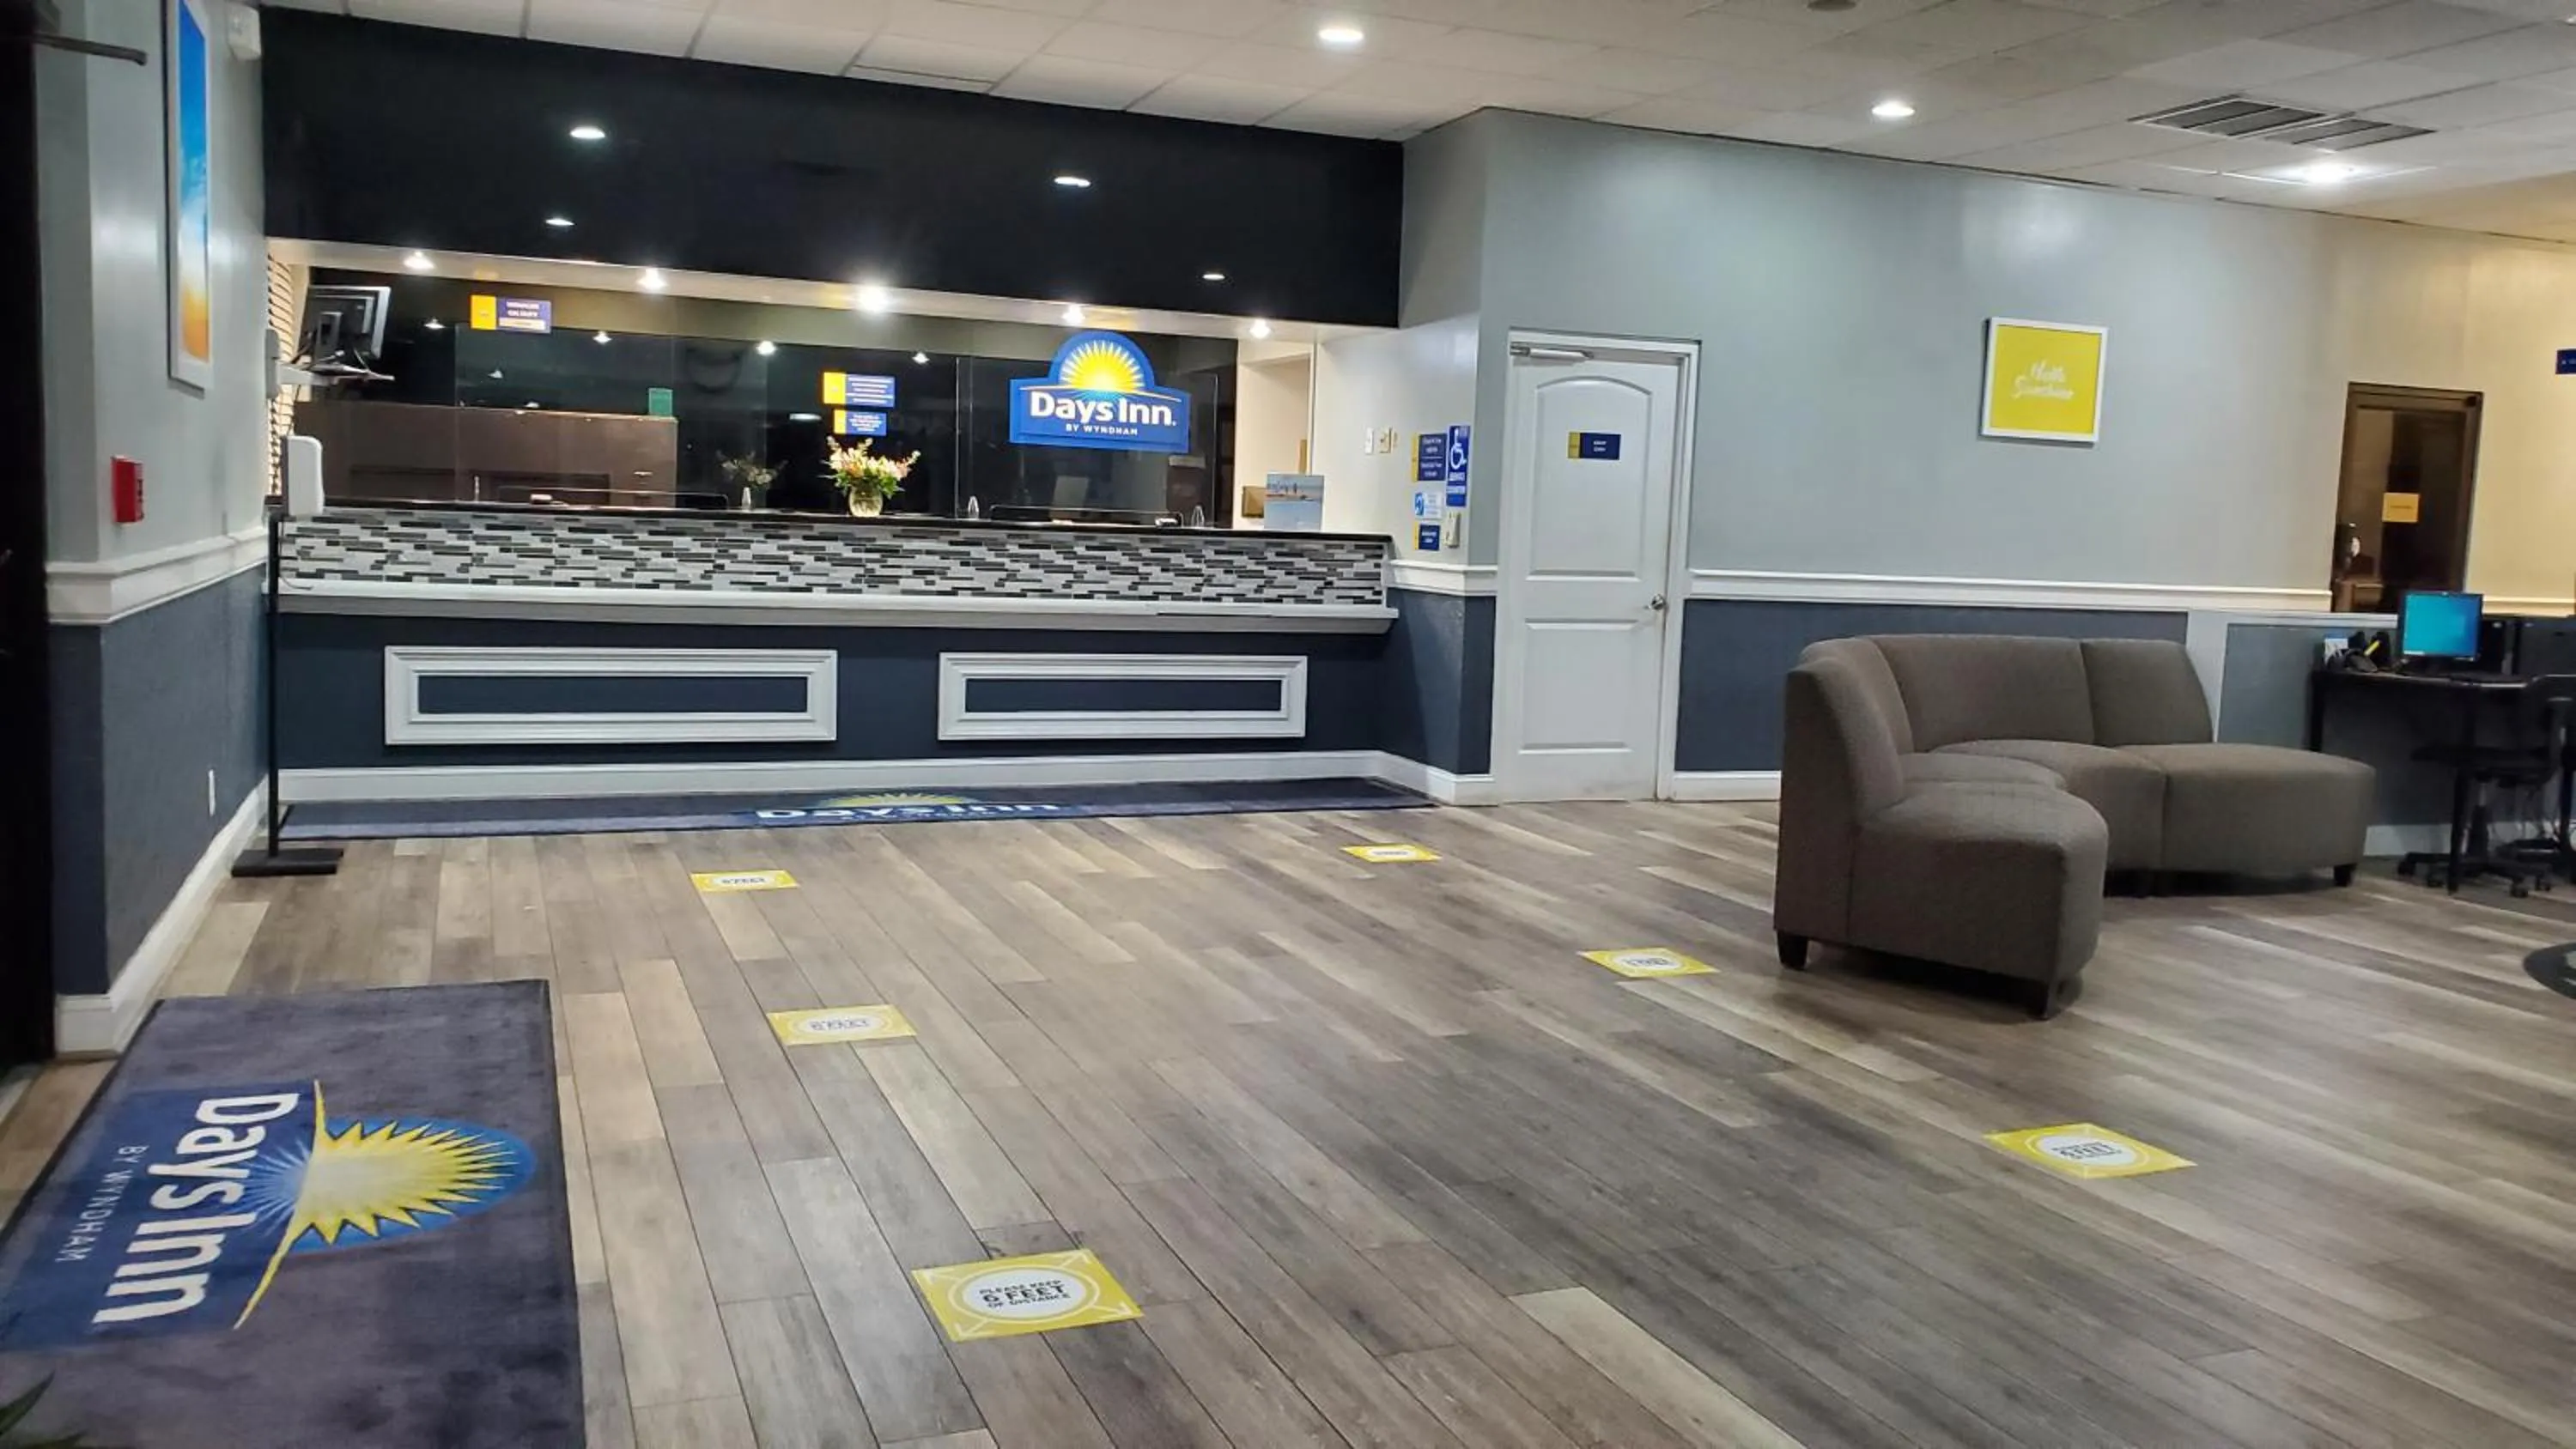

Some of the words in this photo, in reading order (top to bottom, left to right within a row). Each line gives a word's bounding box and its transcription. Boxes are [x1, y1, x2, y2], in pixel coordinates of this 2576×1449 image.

[1030, 391, 1113, 423] Days
[1066, 424, 1079, 433] BY
[1083, 426, 1139, 436] WYNDHAM
[113, 1145, 149, 1162] BY
[148, 1092, 301, 1210] Days
[54, 1169, 133, 1263] WYNDHAM
[92, 1212, 258, 1324] Inn
[983, 1294, 1000, 1303] 6
[1005, 1284, 1066, 1300] FEET
